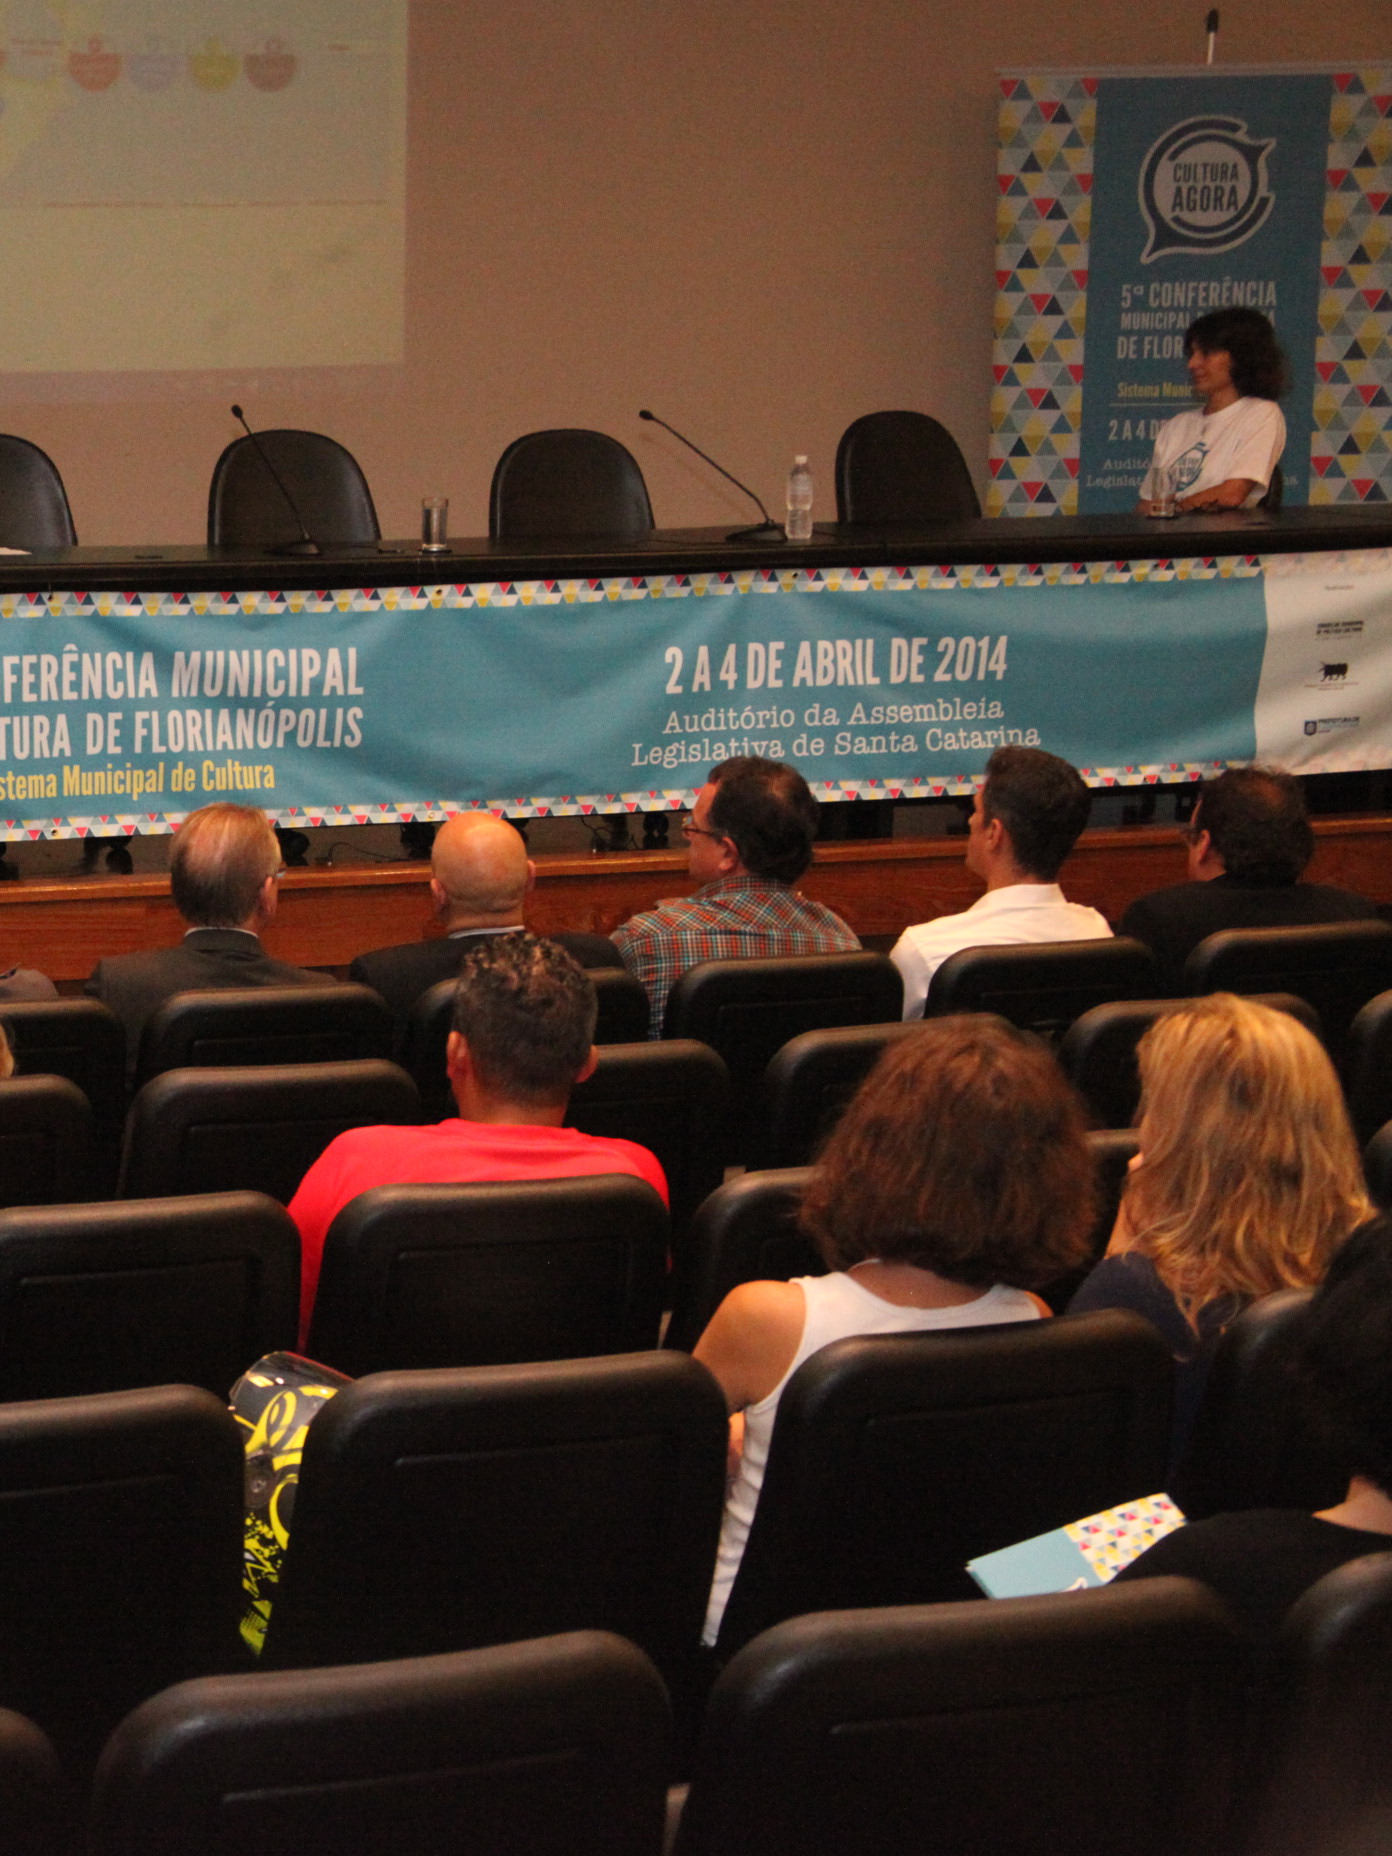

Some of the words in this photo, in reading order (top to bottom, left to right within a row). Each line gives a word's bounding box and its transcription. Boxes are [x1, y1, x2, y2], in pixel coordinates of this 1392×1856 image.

[1173, 162, 1239, 183] CULTURA
[1171, 184, 1239, 213] AGORA
[1149, 276, 1277, 308] CONFERÊNCIA
[1116, 335, 1138, 359] DE
[1117, 382, 1159, 398] Sistema
[1162, 380, 1194, 398] Munic
[1109, 419, 1118, 441] 2
[1122, 419, 1133, 440] A
[1135, 418, 1146, 440] 4
[1103, 457, 1152, 471] Auditó
[171, 647, 364, 698] MUNICIPAL
[664, 646, 684, 694] 2
[692, 645, 712, 692] A
[719, 643, 738, 690] 4
[746, 641, 785, 689] DE
[792, 638, 881, 687] ABRIL
[889, 637, 928, 684] DE
[933, 635, 1008, 682] 2014
[86, 712, 123, 755] DE
[134, 701, 364, 754] FLORIANÓPOLIS
[662, 705, 795, 734] Auditório
[804, 703, 840, 726] da
[847, 697, 1005, 725] Assembleia
[631, 736, 786, 769] Legislativa
[792, 733, 825, 757] de
[834, 731, 918, 756] Santa
[925, 725, 1042, 752] Catarina
[63, 762, 164, 801] Municipal
[171, 761, 196, 792] de
[202, 759, 275, 791] Cultura
